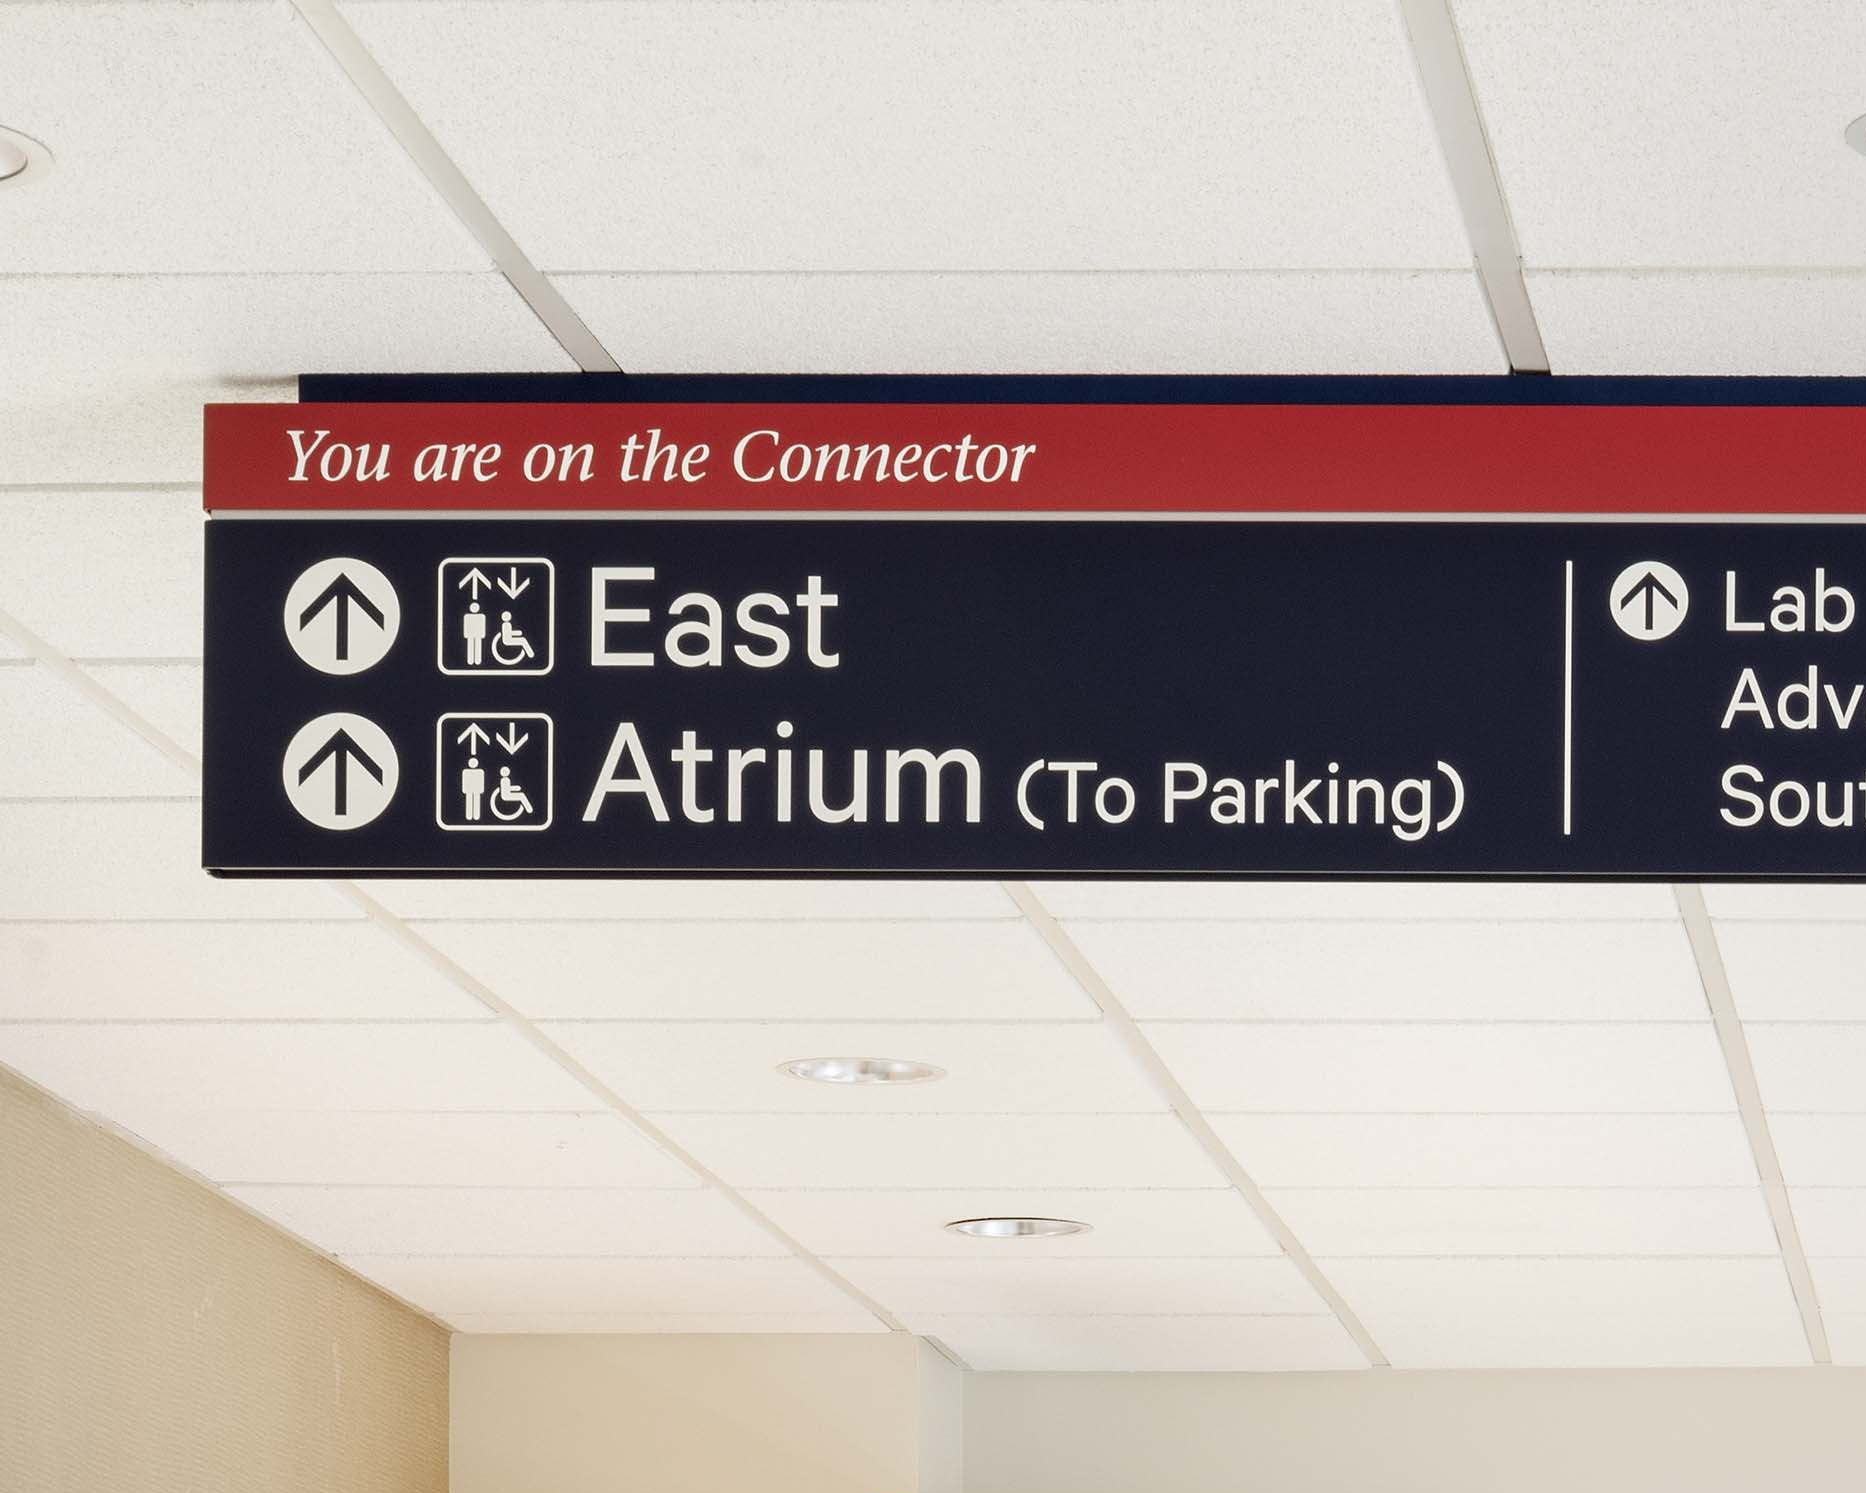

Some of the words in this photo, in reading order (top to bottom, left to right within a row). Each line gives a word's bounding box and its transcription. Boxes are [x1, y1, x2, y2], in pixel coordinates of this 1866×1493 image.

[286, 430, 391, 482] You
[413, 443, 502, 482] are
[523, 443, 595, 482] on
[620, 428, 710, 483] the
[733, 429, 1037, 483] Connector
[590, 566, 840, 669] East
[1725, 567, 1856, 633] Lab
[581, 720, 981, 824] Atrium
[1016, 758, 1136, 831] (To
[1164, 759, 1465, 842] Parking)
